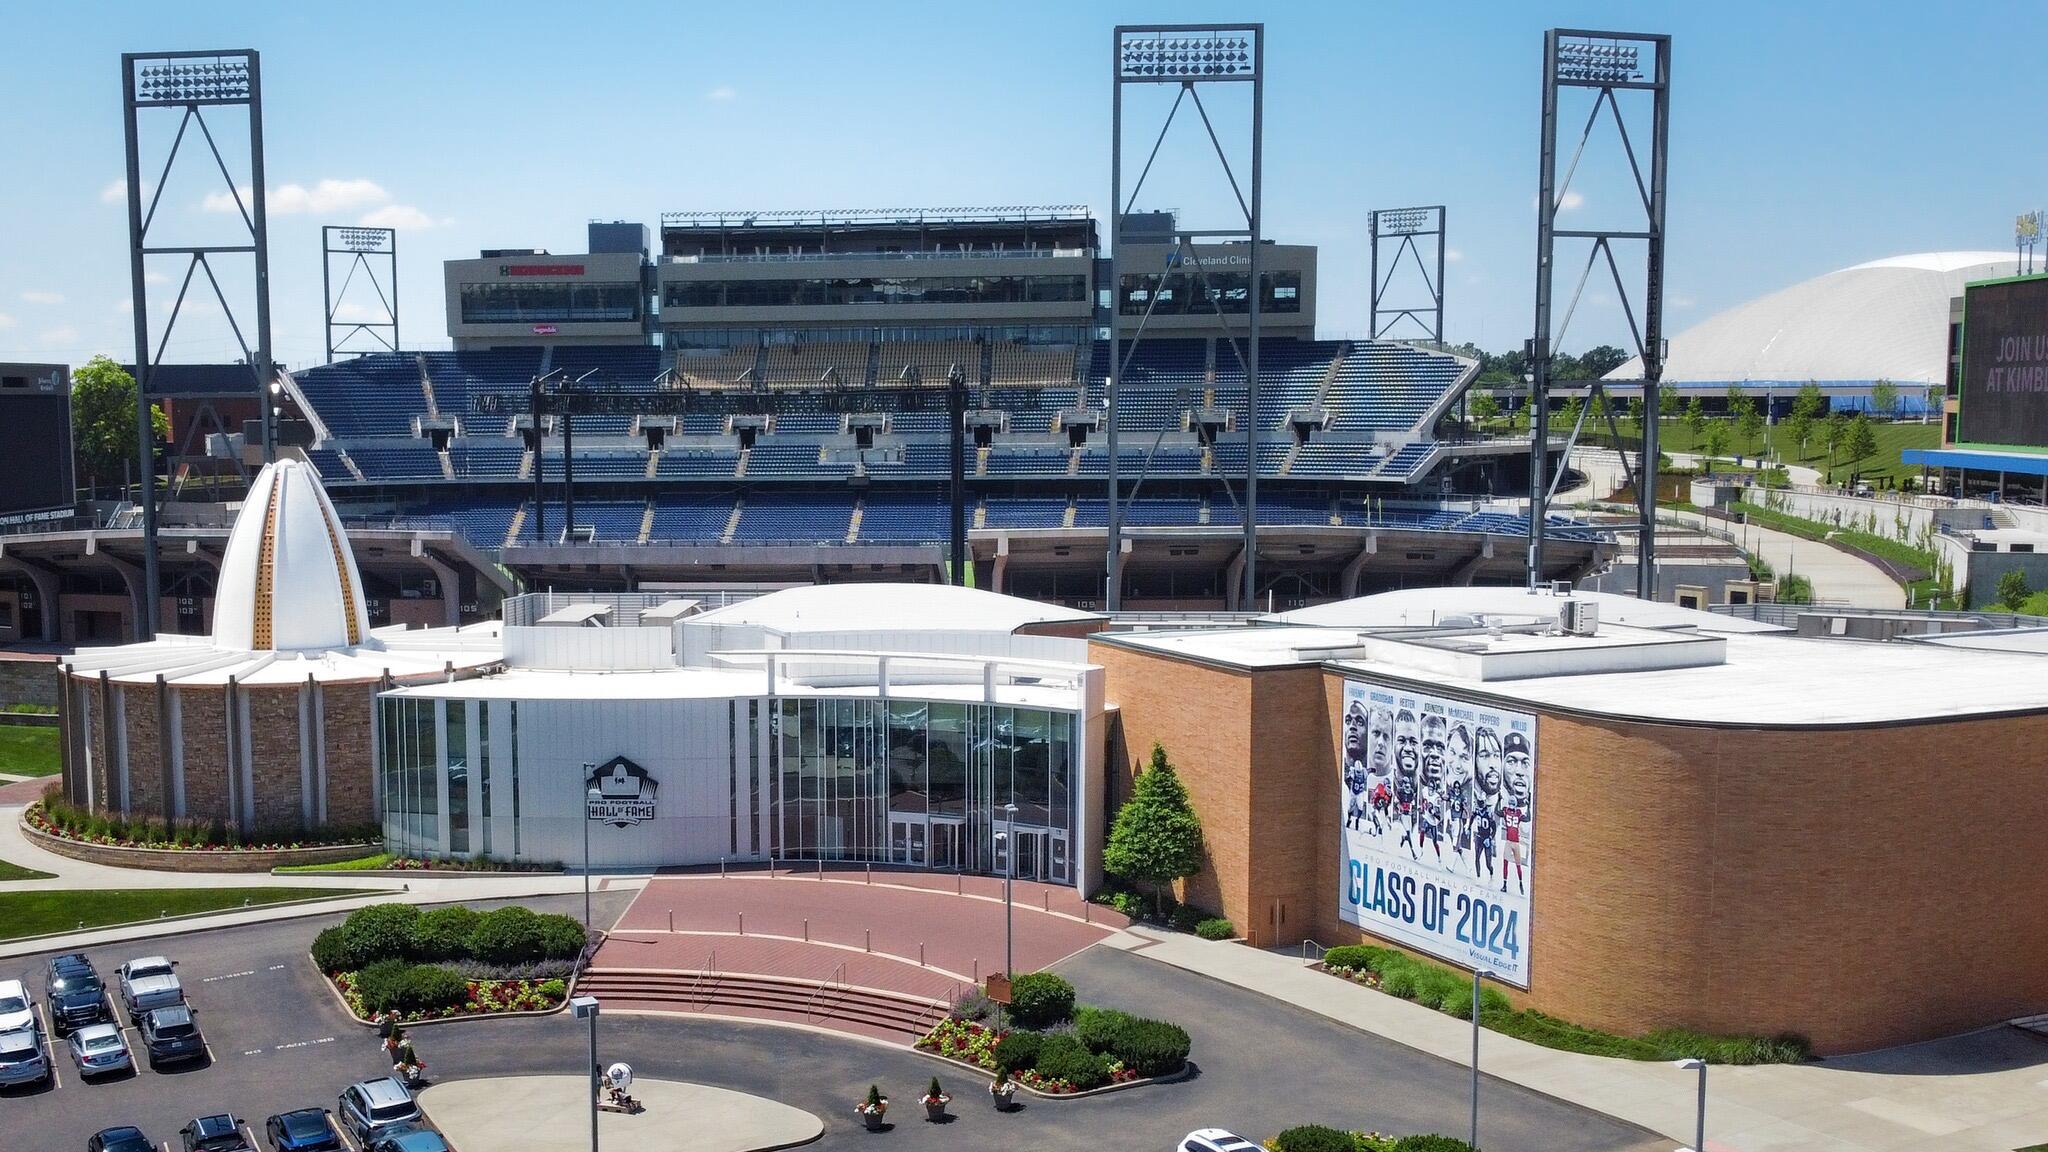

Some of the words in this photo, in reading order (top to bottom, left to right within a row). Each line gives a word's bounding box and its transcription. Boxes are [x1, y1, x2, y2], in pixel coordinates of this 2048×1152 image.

[1183, 255, 1228, 266] Cleveland
[1229, 255, 1251, 265] Clini
[1996, 335, 2031, 363] JOIN
[2035, 335, 2048, 362] U
[1986, 367, 2004, 393] AT
[9, 514, 25, 524] HALL
[25, 514, 33, 522] OF
[34, 512, 49, 521] FAME
[50, 509, 75, 519] STADIUM
[460, 604, 478, 612] 105
[1077, 600, 1096, 608] 109
[591, 806, 618, 817] HALL
[625, 806, 652, 817] FAME
[1506, 816, 1519, 828] 52
[1385, 861, 1430, 880] FOOTBALL
[1435, 877, 1457, 889] HALL
[1348, 859, 1416, 925] CLASS
[1422, 882, 1450, 935] OF
[1456, 893, 1519, 960] 2024
